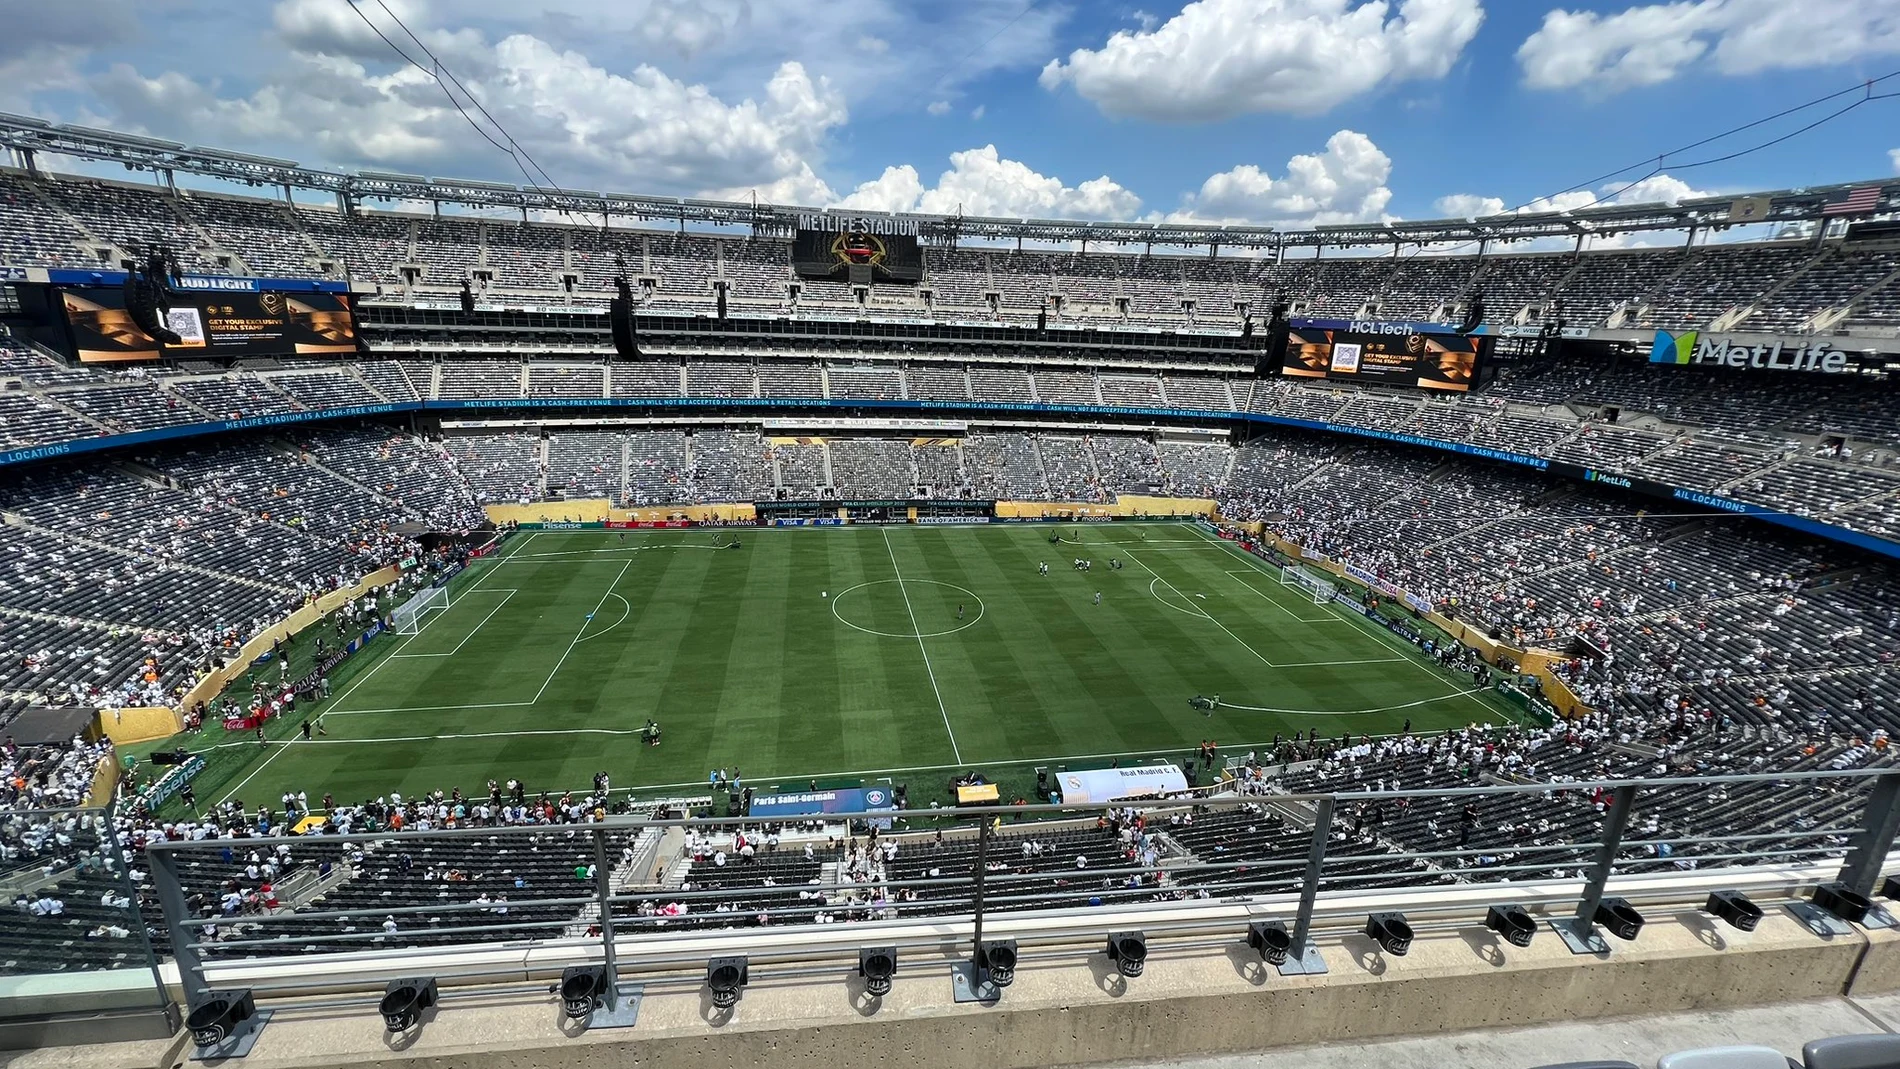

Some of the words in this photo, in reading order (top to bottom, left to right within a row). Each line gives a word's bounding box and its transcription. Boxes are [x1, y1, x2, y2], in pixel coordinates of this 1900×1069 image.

[800, 214, 856, 236] METLIFE
[860, 217, 919, 236] STADIUM
[211, 278, 255, 290] LIGHT
[1349, 321, 1413, 336] HCLTech
[1696, 338, 1847, 373] MetLife
[226, 417, 263, 430] METLIFE
[265, 413, 302, 425] STADIUM
[304, 412, 313, 420] IS
[322, 407, 366, 417] CASH-FREE
[1326, 424, 1353, 433] METLIFE
[1354, 428, 1381, 437] STADIUM
[1396, 435, 1433, 446] CASH-FREE
[1434, 440, 1457, 450] VENUE
[9, 445, 70, 462] LOCATIONS
[1473, 448, 1492, 457] CASH
[1493, 451, 1511, 460] WILL
[1529, 458, 1539, 466] BE
[1597, 473, 1631, 487] MetLife
[1692, 494, 1746, 513] LOCATIONS
[1392, 624, 1412, 640] ULTRA
[294, 670, 319, 693] QATAR
[321, 650, 348, 673] AIRWAYS
[1498, 684, 1510, 694] PIF
[1531, 705, 1543, 716] PIF
[150, 759, 204, 811] Hisense
[754, 797, 776, 805] Paris
[777, 792, 836, 804] Saint-Germain
